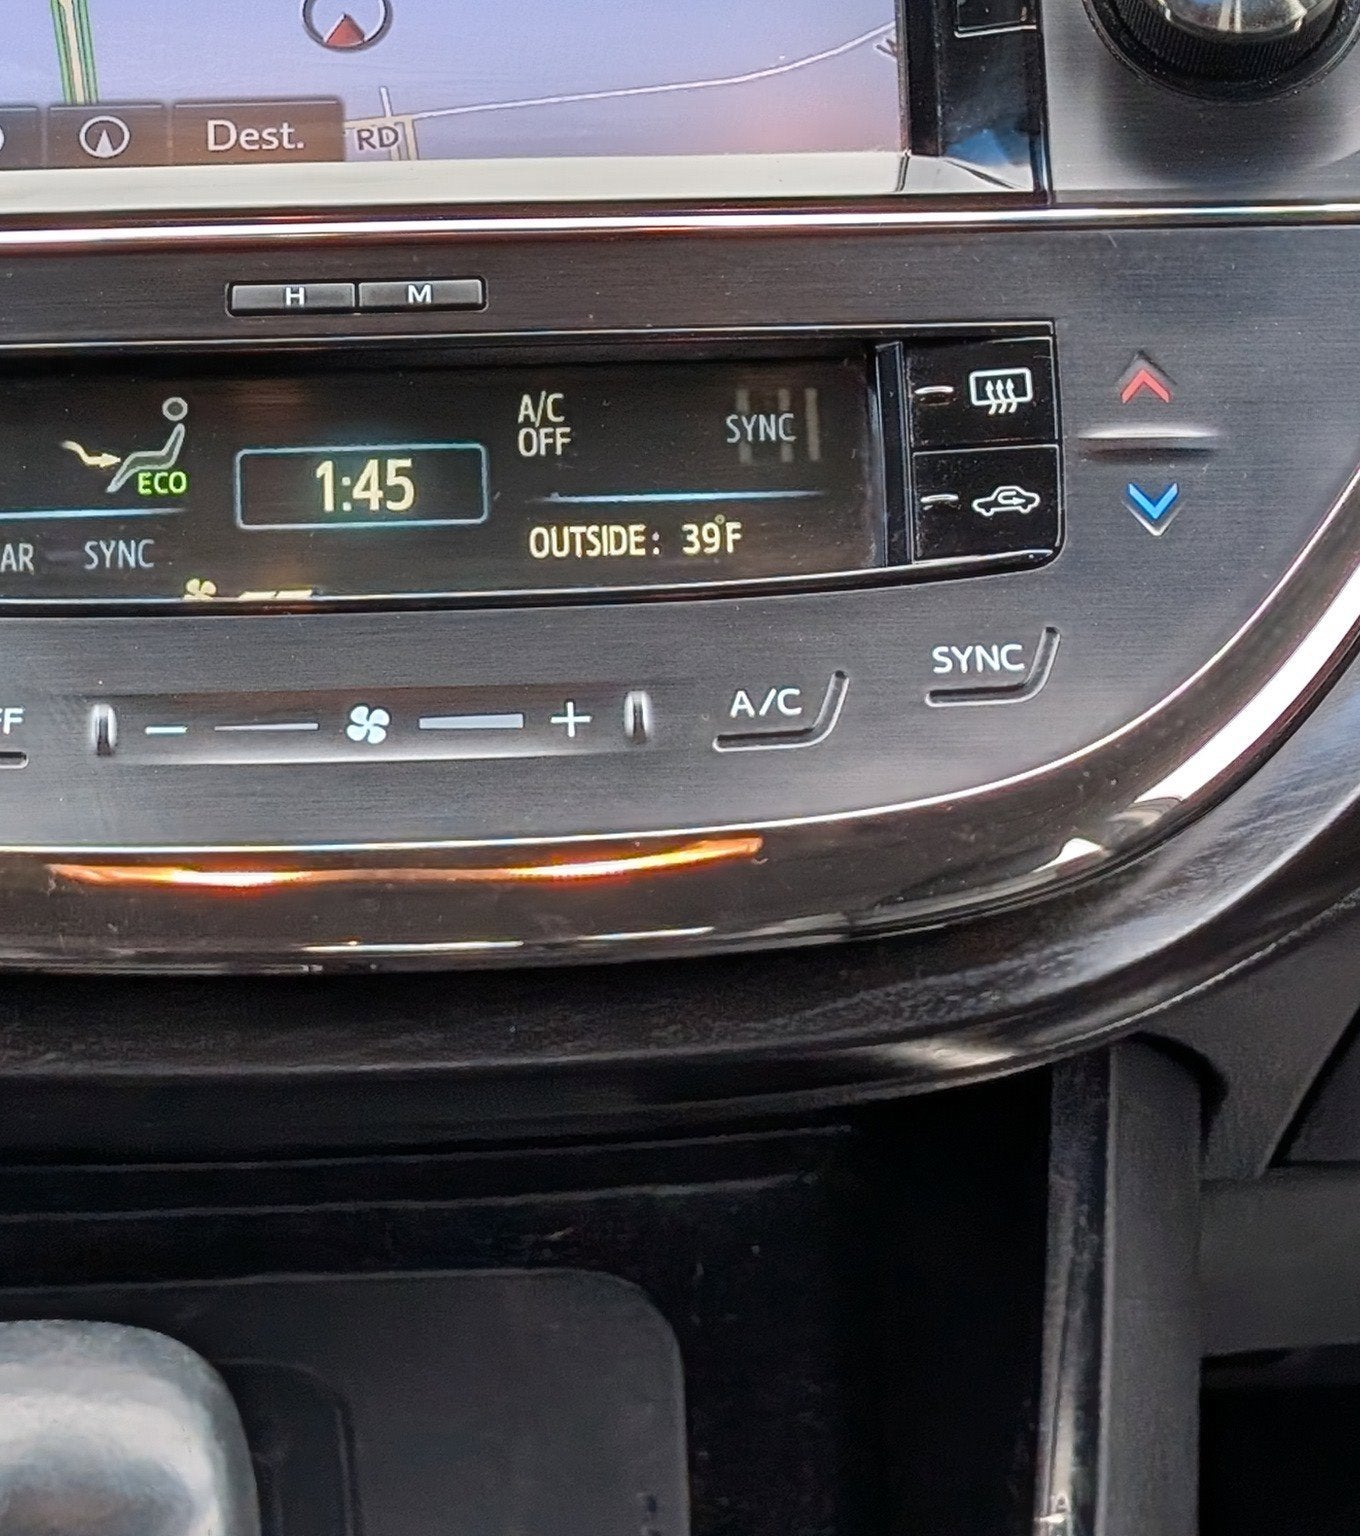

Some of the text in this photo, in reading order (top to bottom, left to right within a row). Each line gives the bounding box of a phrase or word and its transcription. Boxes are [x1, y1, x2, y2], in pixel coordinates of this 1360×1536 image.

[205, 118, 306, 151] Dest.
[356, 125, 399, 151] RD
[285, 286, 306, 307] H
[406, 283, 433, 305] M
[516, 390, 566, 424] A/C
[517, 427, 572, 458] OFF
[725, 412, 798, 444] SYNC
[137, 470, 188, 496] ECO
[315, 457, 416, 513] 1:45
[83, 538, 156, 570] SYNC
[931, 642, 1026, 674] SYNC
[729, 687, 803, 719] A/C
